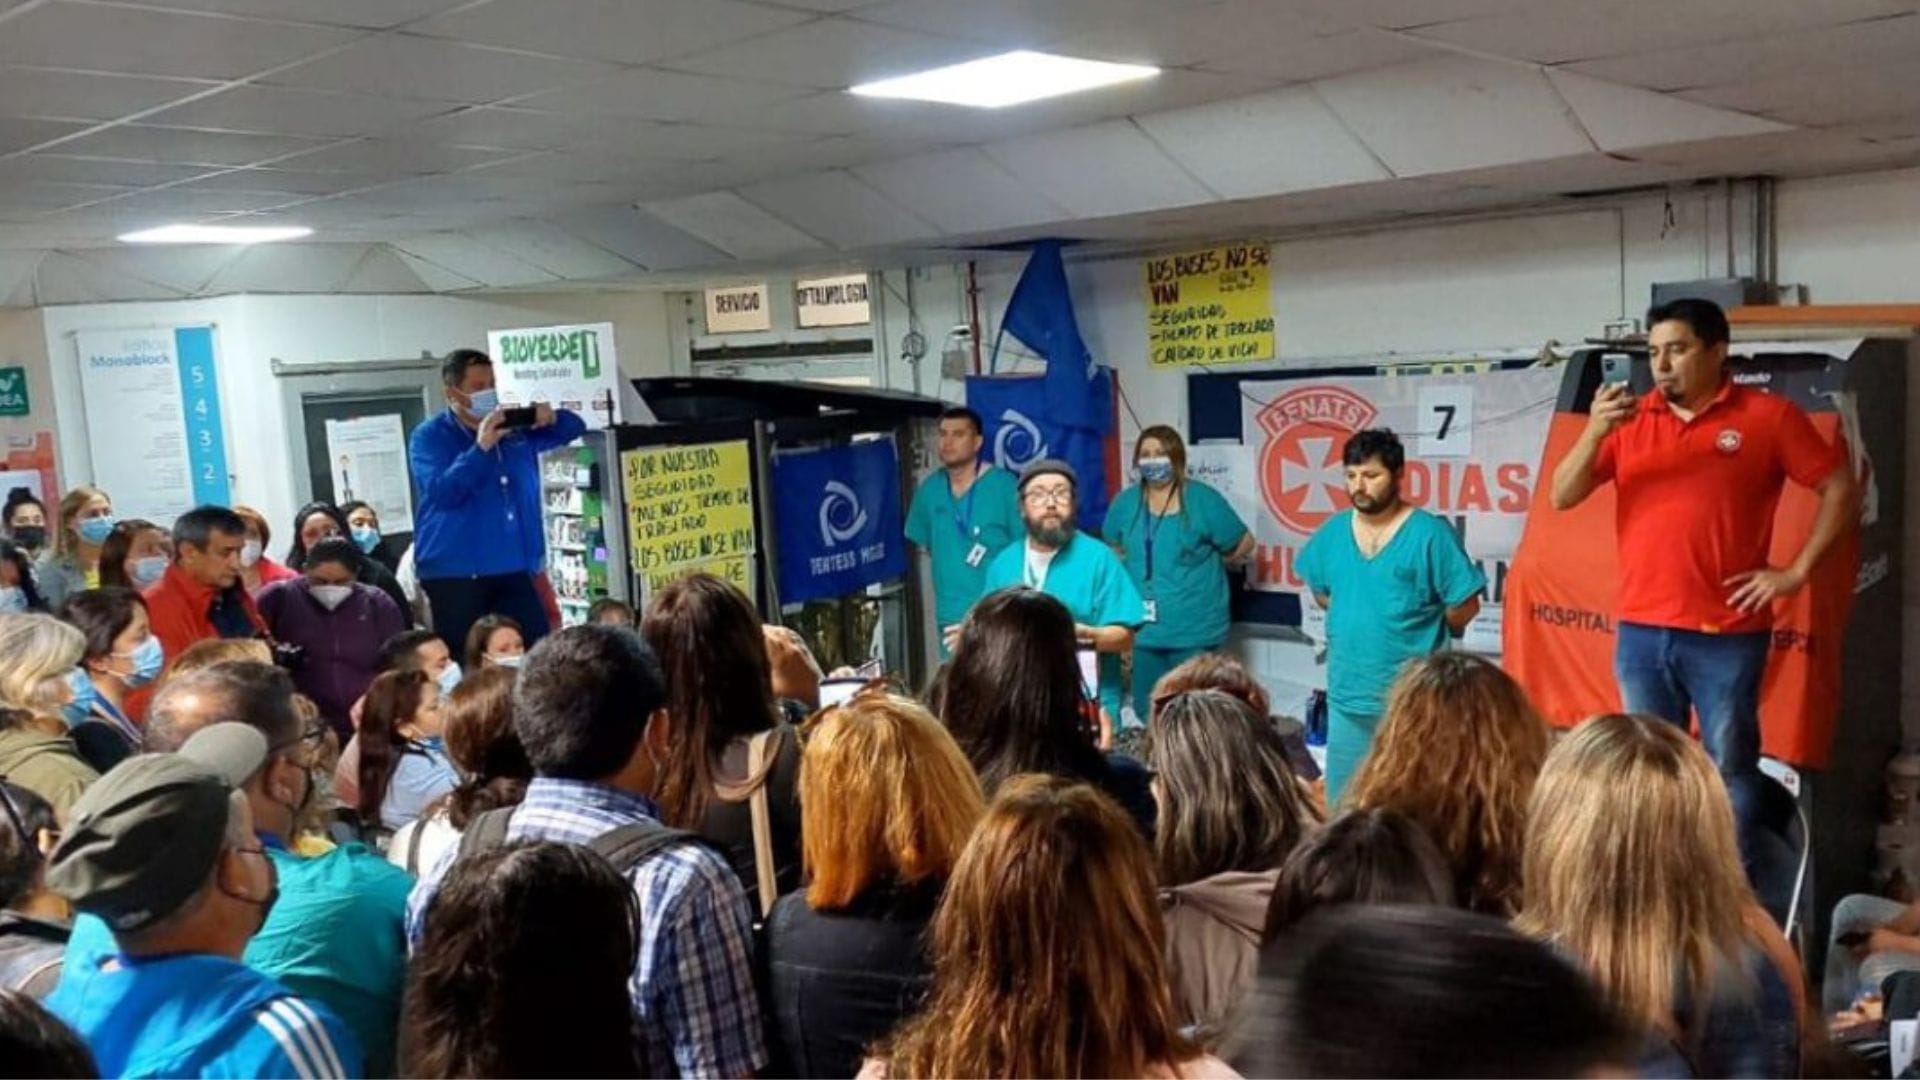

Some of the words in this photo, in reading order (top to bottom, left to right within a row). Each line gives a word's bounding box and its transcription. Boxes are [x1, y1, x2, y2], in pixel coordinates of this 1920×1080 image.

[1147, 258, 1174, 284] LOS
[1174, 250, 1220, 278] BUSES
[1225, 247, 1248, 270] NO
[1250, 247, 1270, 267] SE
[715, 292, 760, 315] SERVICIO
[1150, 281, 1179, 306] VAN
[500, 331, 580, 364] BIOVERDE
[191, 365, 204, 384] 5
[195, 398, 208, 417] 4
[1270, 396, 1362, 430] FENATS
[1432, 405, 1456, 441] 7
[199, 428, 213, 448] 3
[203, 462, 216, 480] 2
[1399, 460, 1530, 513] DIAS
[1529, 602, 1617, 634] HOSPITAL
